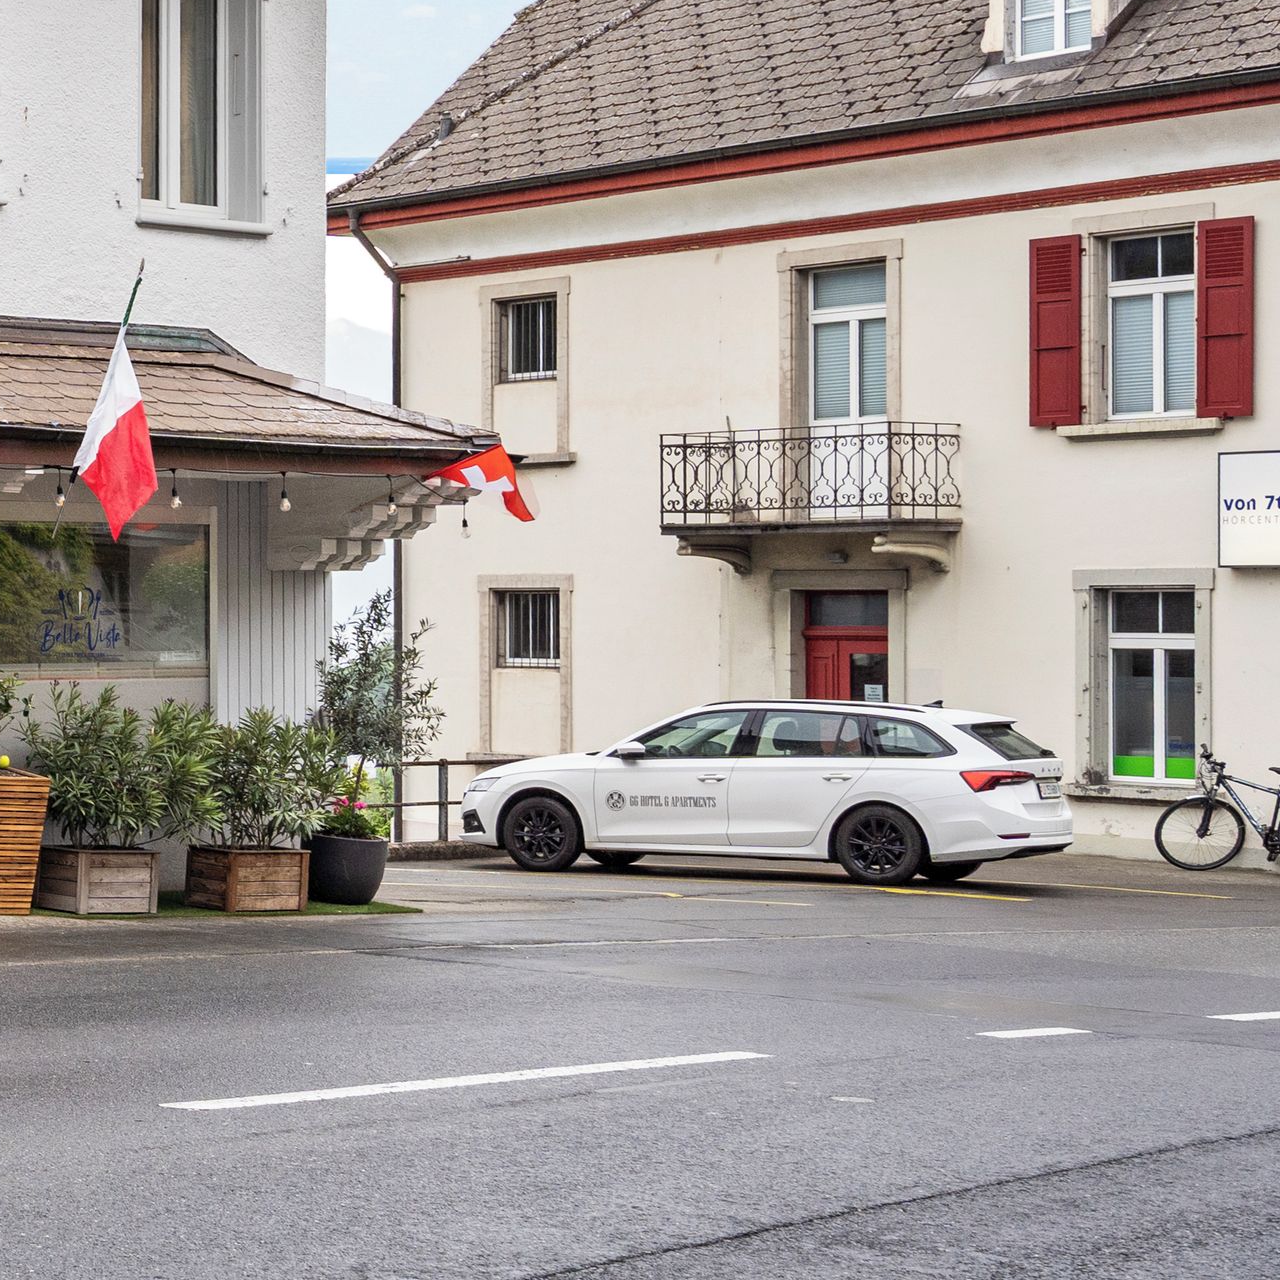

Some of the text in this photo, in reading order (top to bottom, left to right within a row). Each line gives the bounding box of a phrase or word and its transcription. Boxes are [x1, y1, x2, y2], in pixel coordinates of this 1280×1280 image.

[1223, 497, 1256, 511] von
[34, 618, 122, 652] Bella Vista
[640, 795, 663, 807] HOTEL
[671, 796, 717, 808] APARTMENTS
